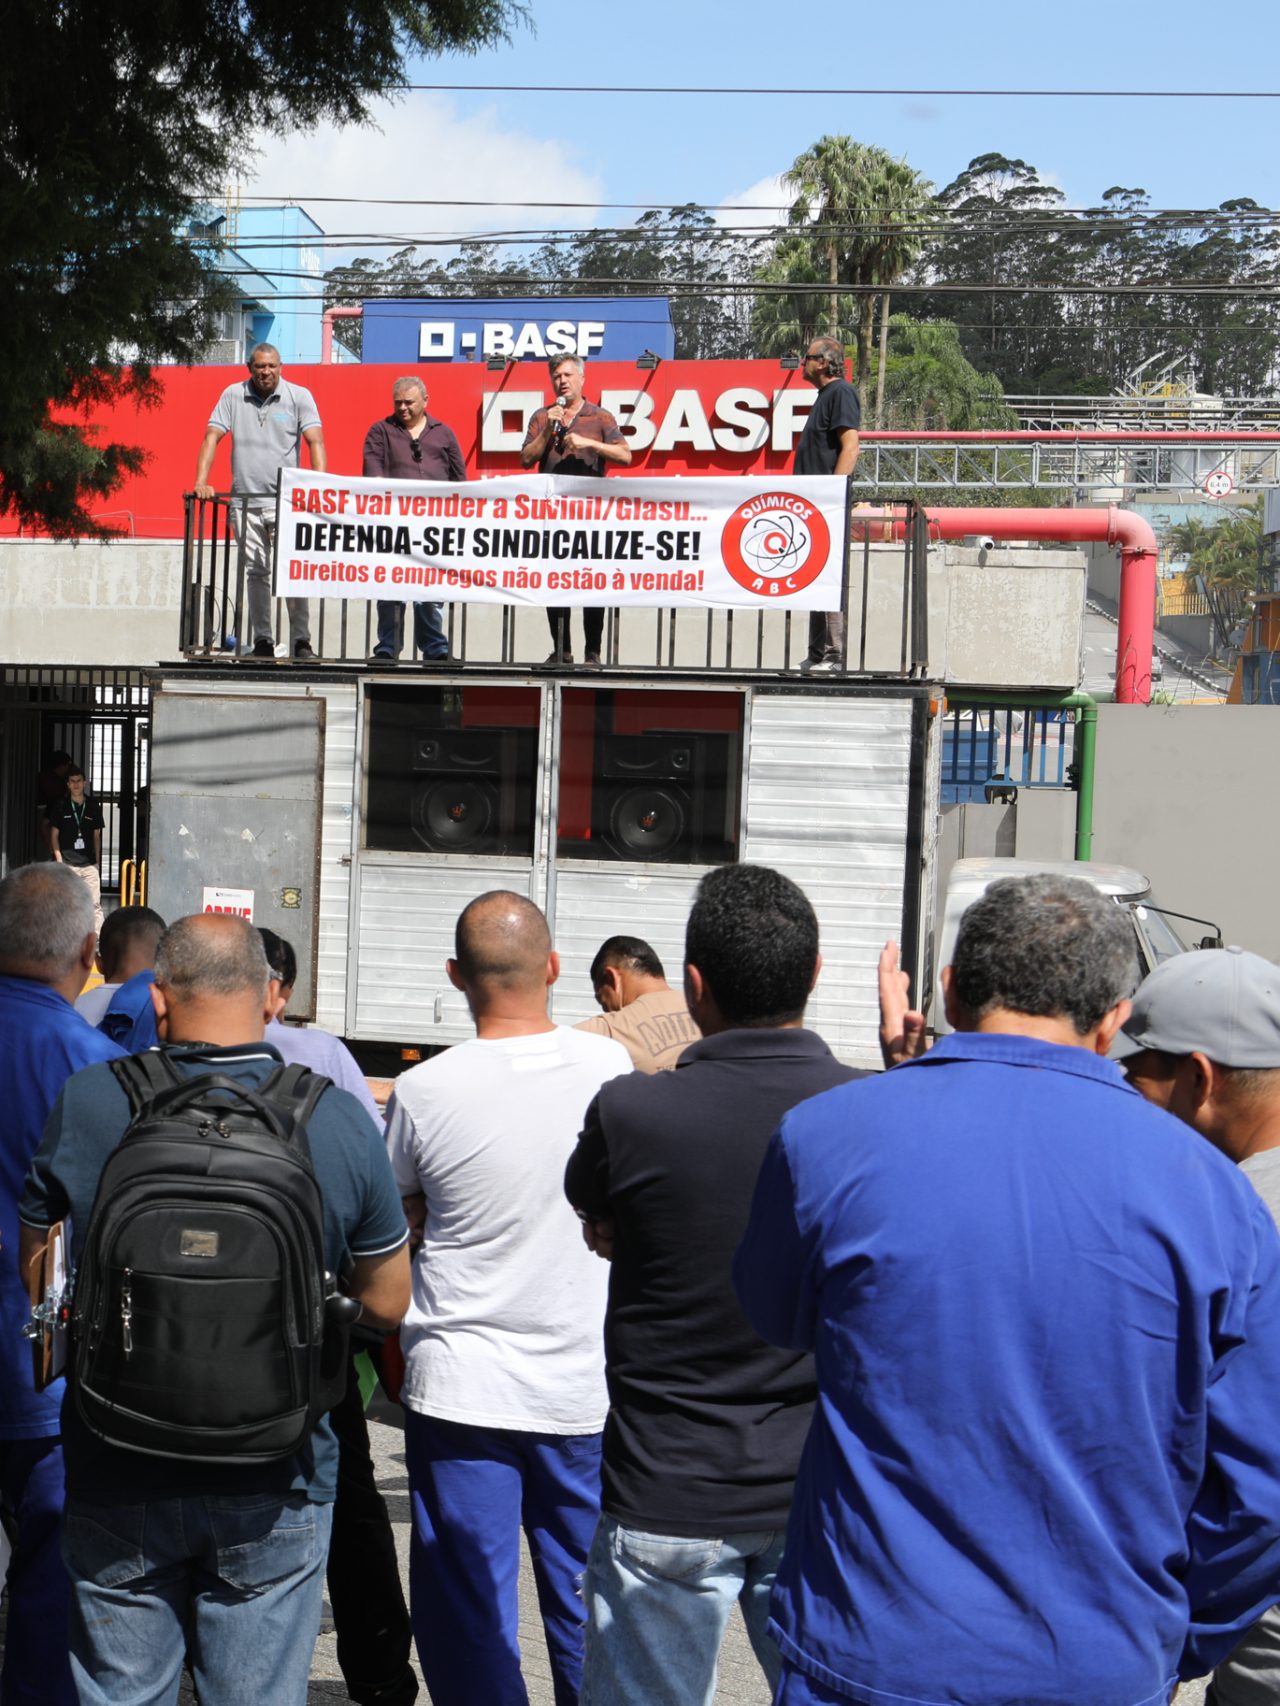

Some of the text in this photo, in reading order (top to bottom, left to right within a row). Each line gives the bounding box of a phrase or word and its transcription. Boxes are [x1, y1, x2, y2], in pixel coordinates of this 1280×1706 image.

[483, 321, 605, 357] BASF
[600, 388, 818, 453] BASF
[291, 488, 708, 521] BASF vai vender a Suvinil/Glasu...
[741, 495, 813, 520] QUÍMICOS
[295, 522, 701, 561] DEFENDA-SE! SINDICALIZE-SE!
[289, 559, 704, 591] Direitos e empregos não estão à venda!
